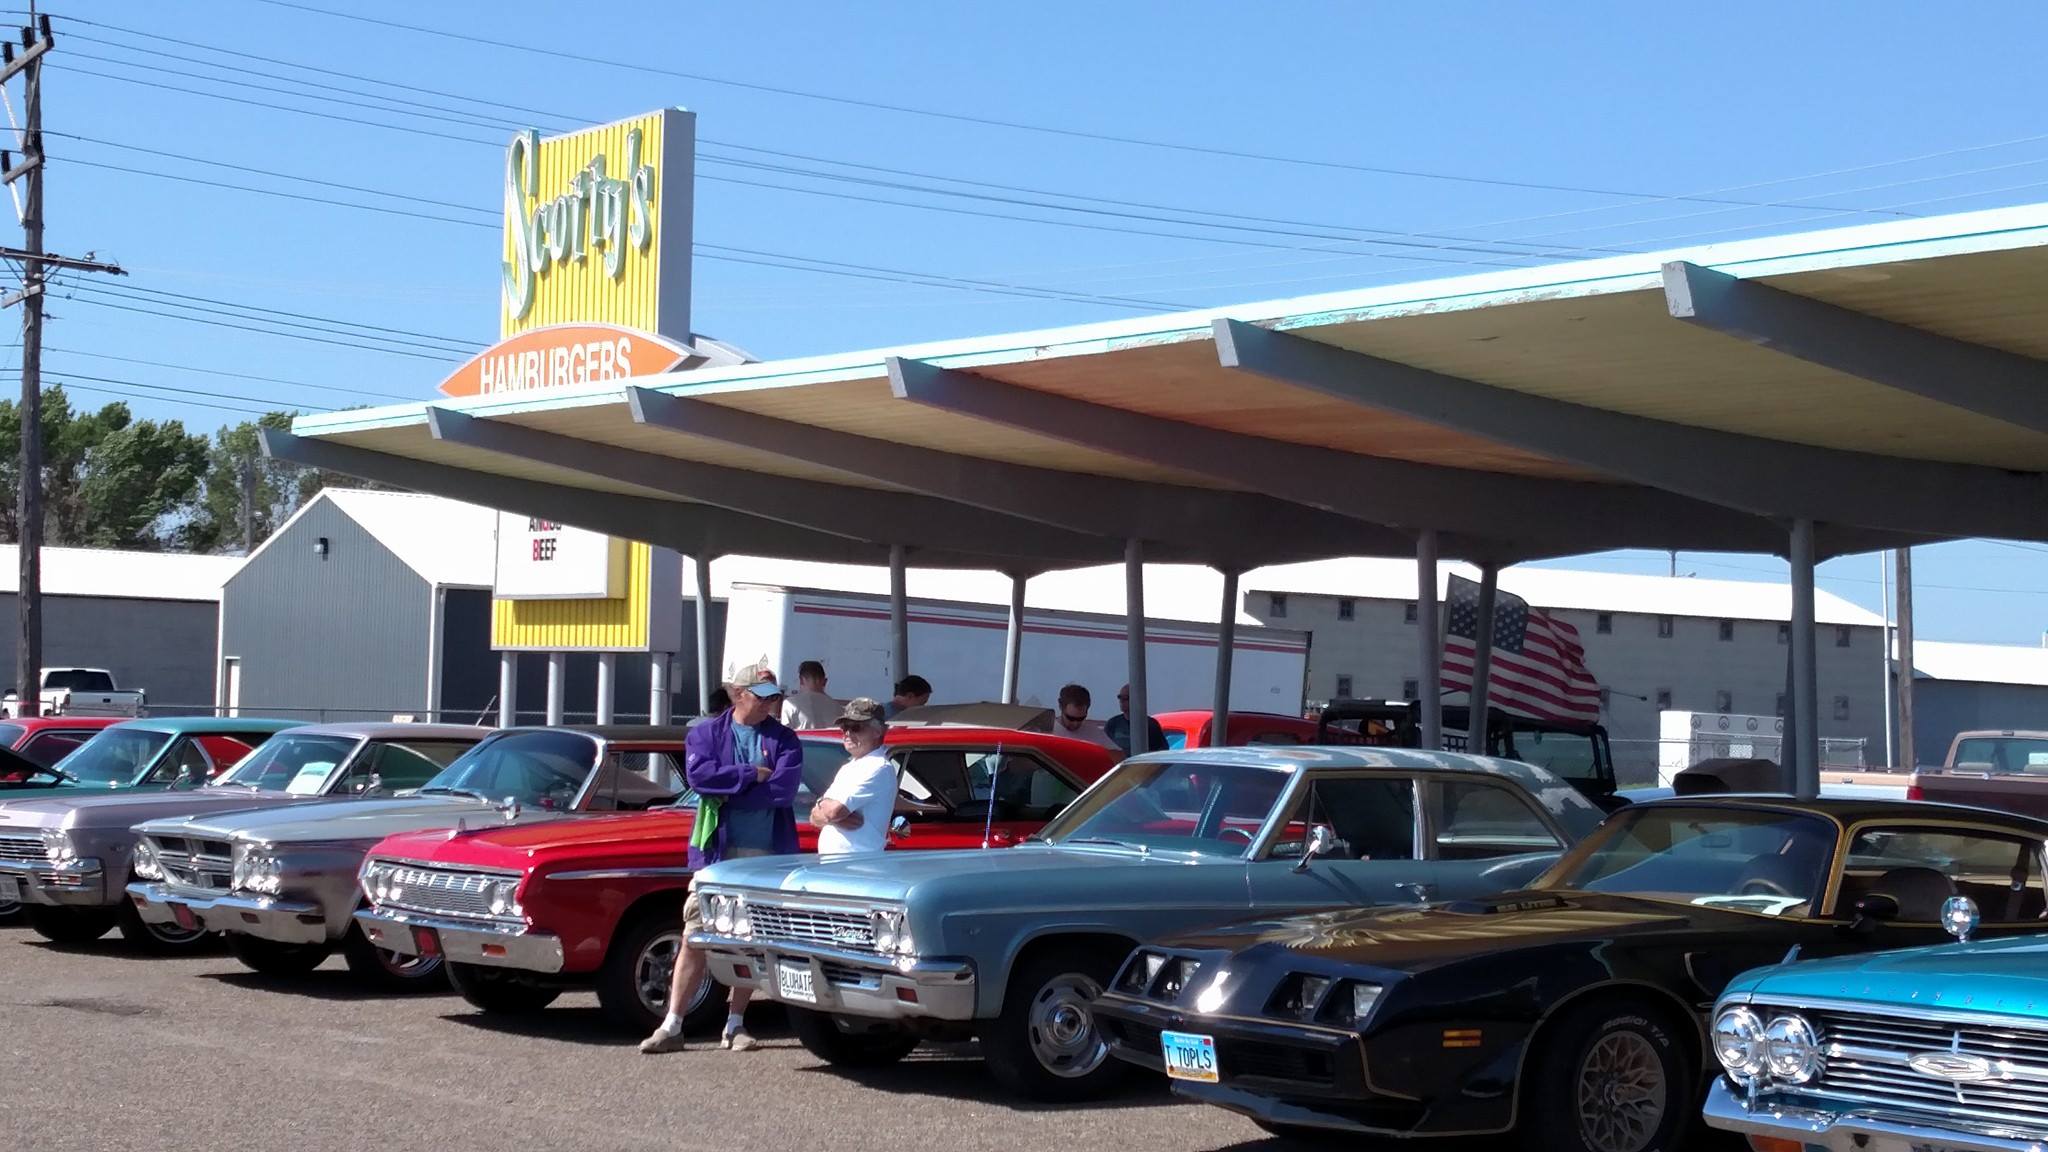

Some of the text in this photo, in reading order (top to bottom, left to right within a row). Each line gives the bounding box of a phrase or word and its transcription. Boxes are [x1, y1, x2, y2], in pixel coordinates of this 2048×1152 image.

[502, 126, 655, 320] Scotty's
[480, 336, 632, 395] HAMBURGERS
[533, 538, 557, 561] BEEF
[1165, 1044, 1212, 1069] T TOPLS
